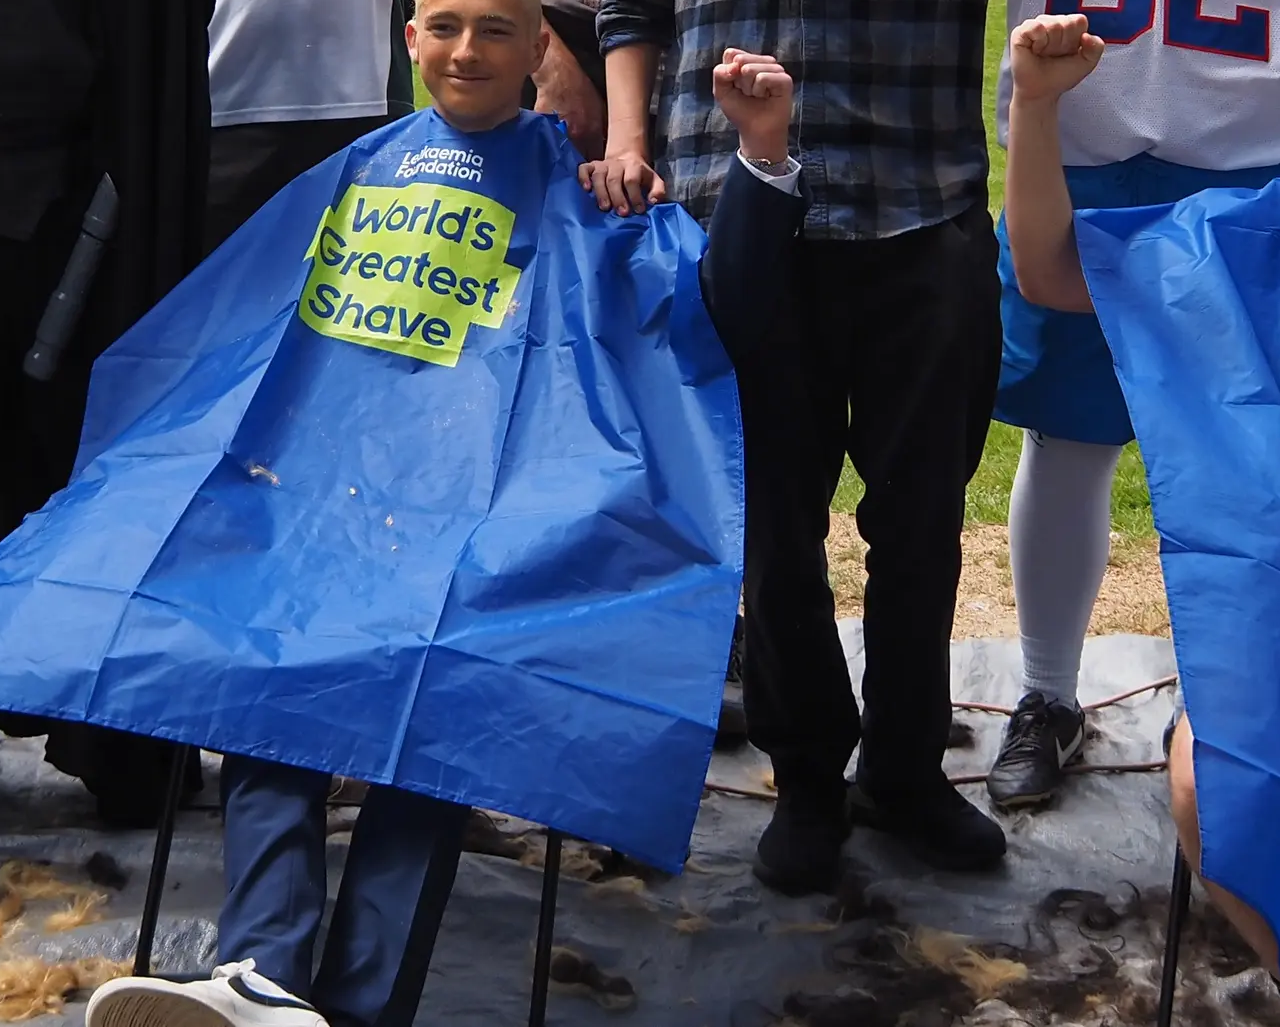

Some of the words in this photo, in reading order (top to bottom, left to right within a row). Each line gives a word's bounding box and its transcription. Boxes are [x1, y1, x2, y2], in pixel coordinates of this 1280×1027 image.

[351, 197, 498, 252] World's
[318, 226, 500, 313] Greatest
[308, 282, 452, 347] Shave
